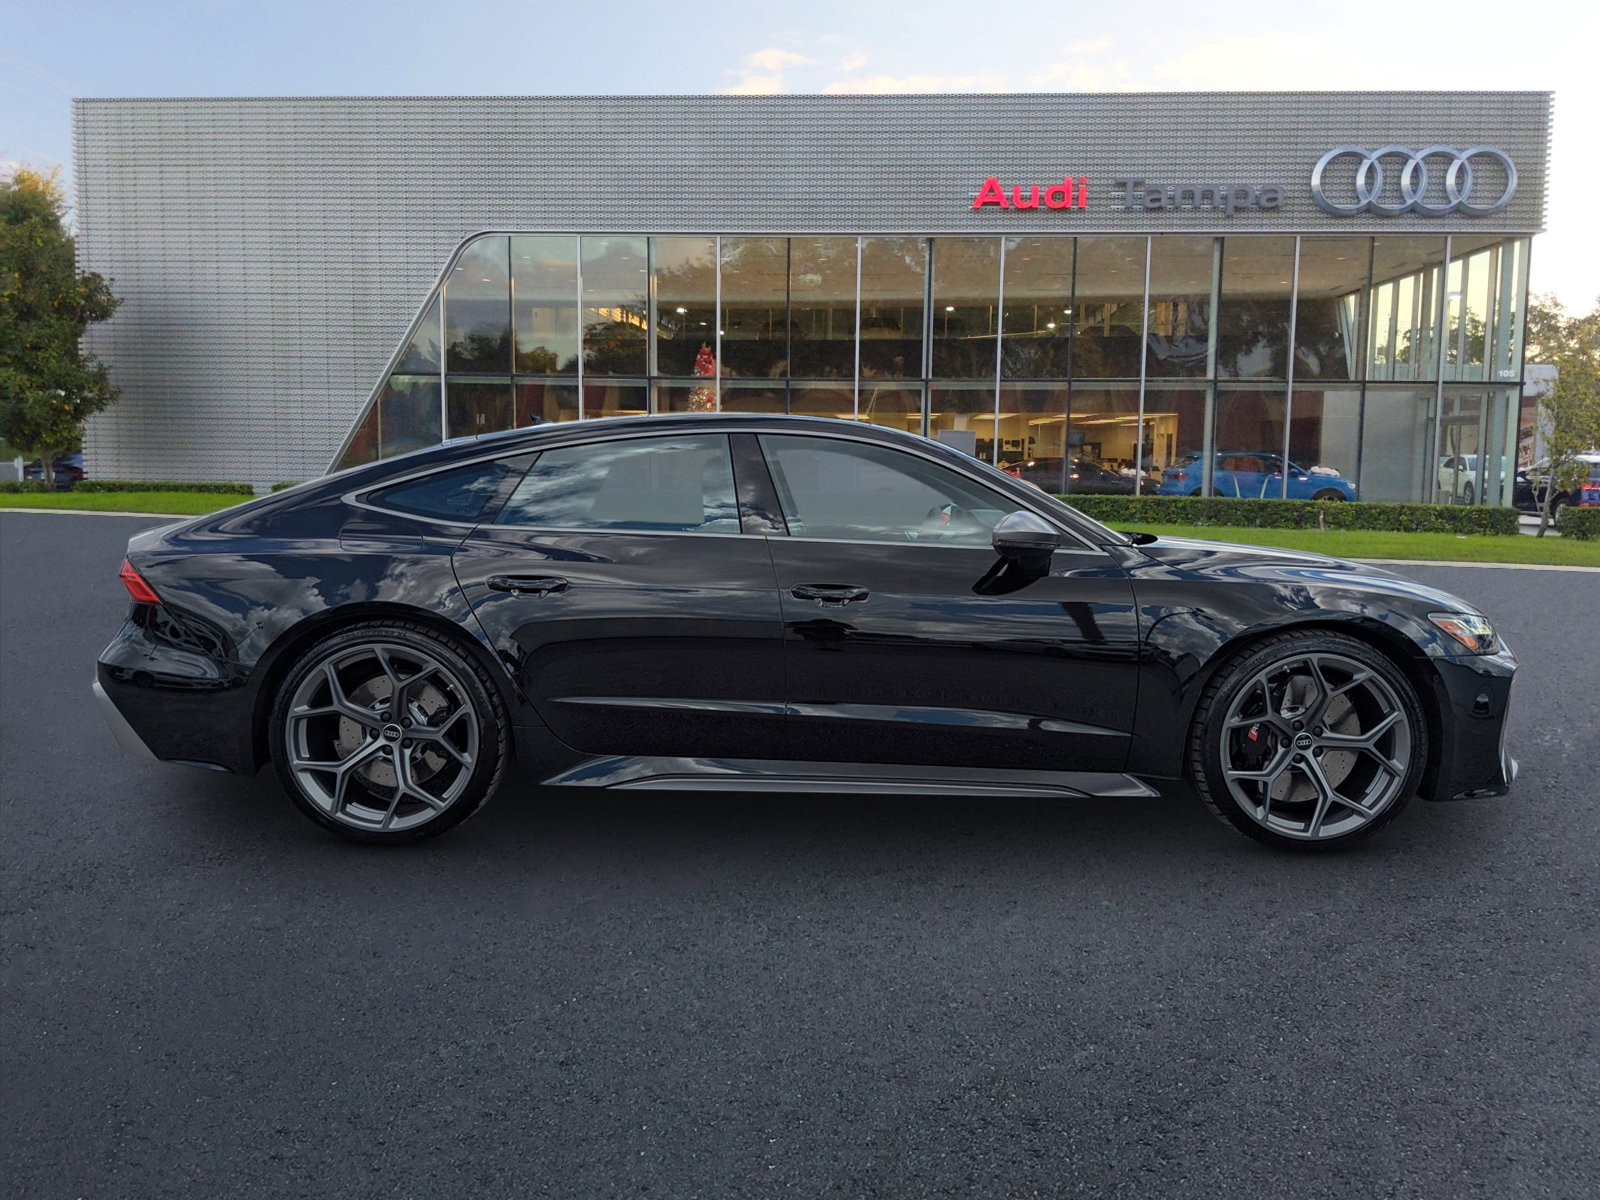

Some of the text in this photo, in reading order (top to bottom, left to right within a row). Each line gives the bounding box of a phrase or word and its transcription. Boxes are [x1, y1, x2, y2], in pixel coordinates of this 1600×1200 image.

[973, 176, 1285, 217] Audi Tampa
[1498, 369, 1515, 377] 105
